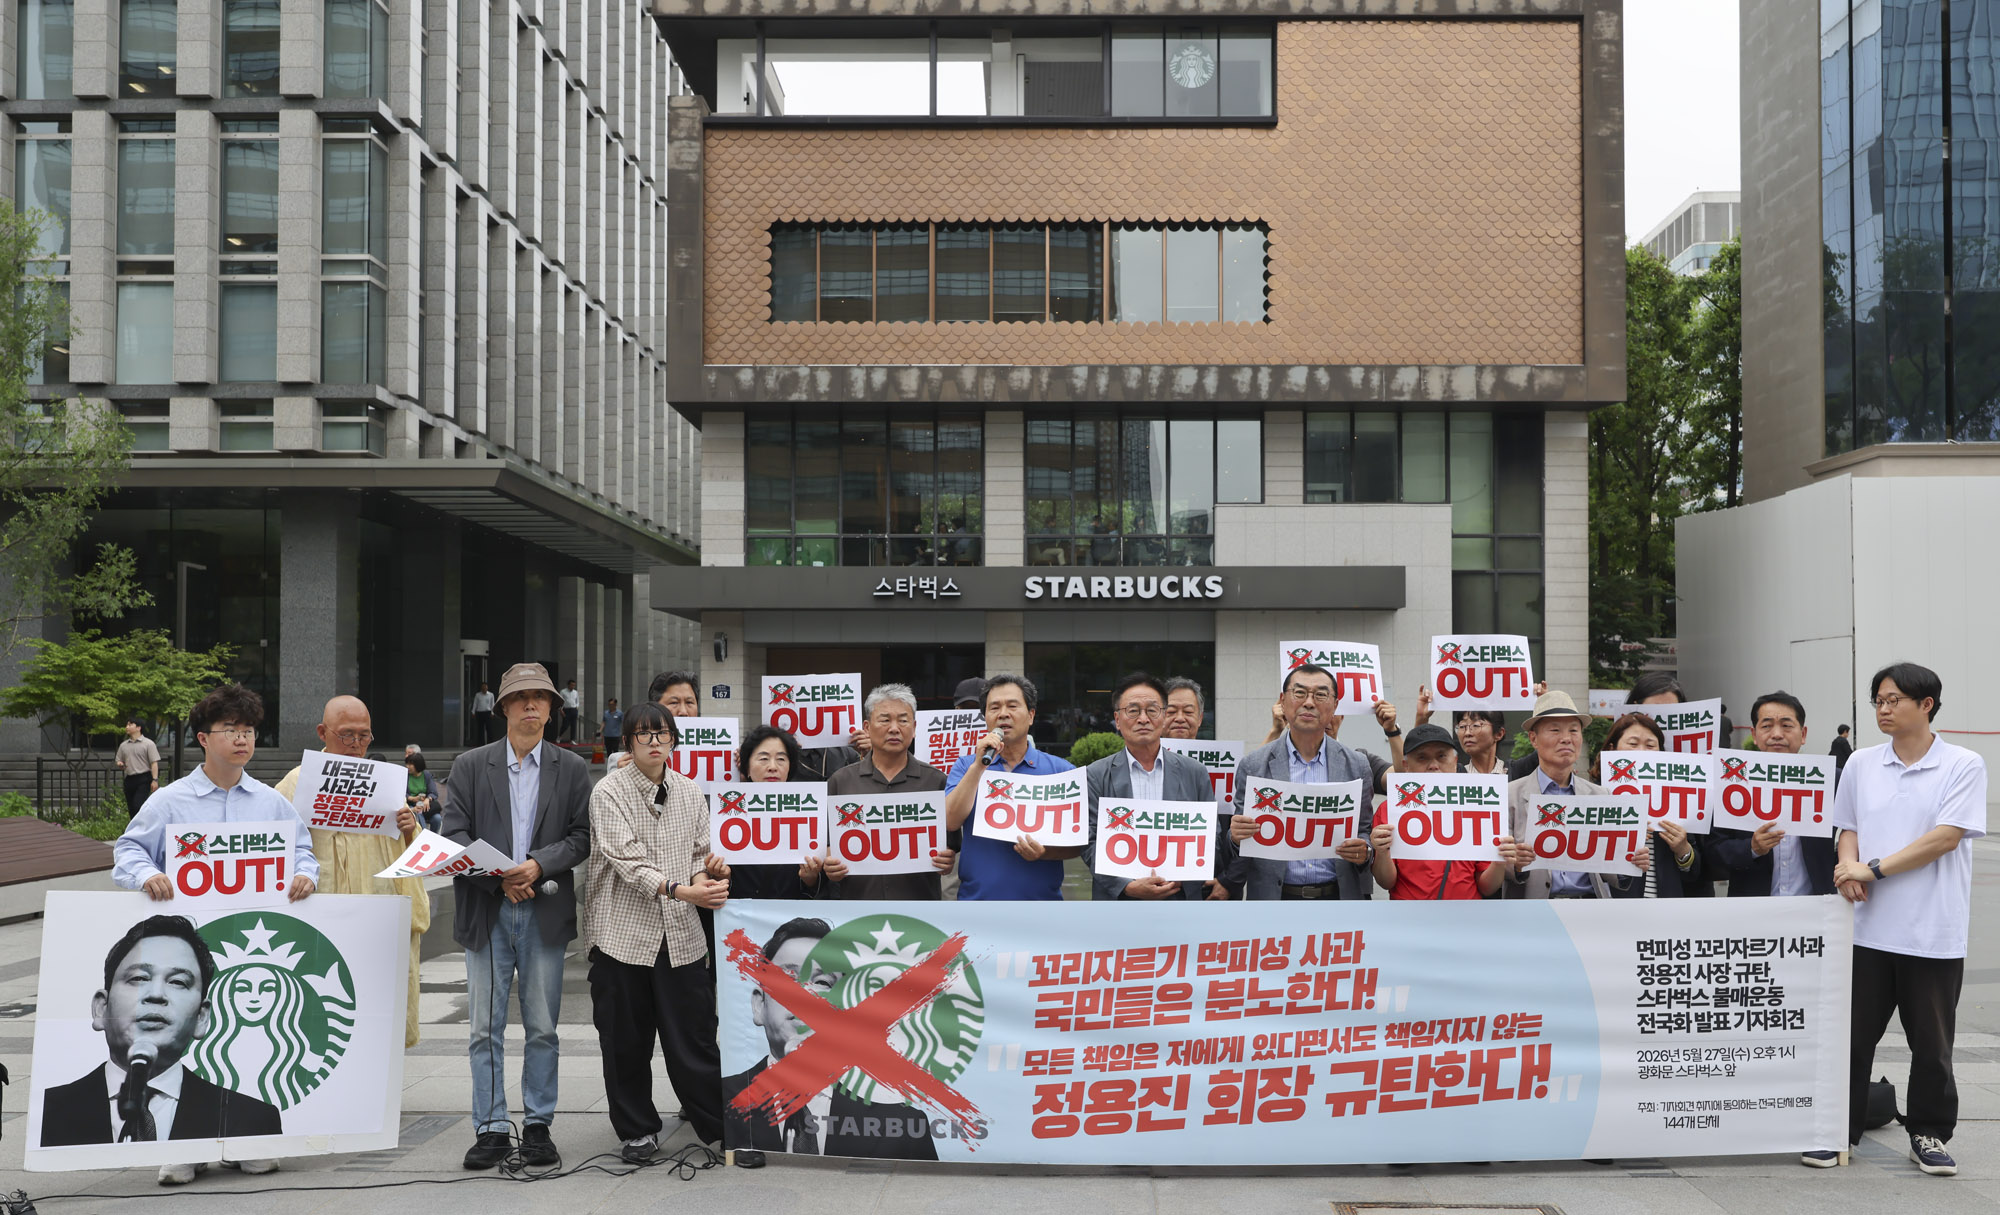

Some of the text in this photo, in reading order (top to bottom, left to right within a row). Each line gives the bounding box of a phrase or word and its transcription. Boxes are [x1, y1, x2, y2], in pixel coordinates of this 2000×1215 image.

[873, 576, 961, 600] 스타벅스
[1025, 575, 1223, 600] STARBUCKS
[1314, 650, 1374, 669] 스타벅스
[1463, 645, 1525, 663] 스타벅스
[795, 683, 854, 702] 스타벅스
[1436, 666, 1529, 698] OUT!
[770, 705, 857, 736] OUT!
[928, 713, 986, 732] 스타벅스
[928, 732, 958, 748] 역사
[322, 760, 375, 780] 대국민
[666, 750, 732, 782] UT!
[1638, 762, 1707, 782] 스타벅스
[1748, 763, 1825, 784] 스타벅스
[319, 777, 377, 797] 사과쇼!
[1014, 780, 1081, 801] 스타벅스
[1427, 785, 1500, 805] 스타벅스
[313, 794, 366, 813] 정용진
[747, 793, 818, 812] 스타벅스
[866, 803, 937, 824] 스타벅스
[1283, 794, 1355, 814] 스타벅스
[1612, 784, 1707, 821] UT!
[1722, 784, 1824, 823] OUT!
[311, 810, 386, 829] 규탄한다!
[984, 802, 1081, 834] OUT!
[1135, 811, 1207, 830] 스타벅스
[1566, 806, 1639, 825] 스타벅스
[719, 817, 818, 851] OUT!
[1252, 814, 1354, 848] OUT!
[1398, 810, 1501, 847] OUT!
[209, 833, 286, 854] 스타벅스
[839, 826, 938, 862] OUT!
[1105, 833, 1207, 868] OUT!
[1533, 829, 1638, 862] OUT!
[176, 857, 286, 897] OUT!
[1197, 936, 1292, 976] 면피성
[1299, 930, 1365, 967] 사과
[1636, 936, 1825, 960] 면피성 꼬리자르기 사과
[1636, 961, 1775, 985] 정용진 사장 규탄,
[1034, 982, 1193, 1032] 국민들은
[1636, 986, 1785, 1009] 스타벅스 불매운동
[1637, 1008, 1805, 1034] 전국화 발표 기자회견
[1083, 1042, 1160, 1072] 책임은
[1166, 1035, 1245, 1066] 저에게
[1251, 1025, 1377, 1062] 있다면서도
[1384, 1016, 1486, 1048] 책임지지
[1491, 1012, 1543, 1041] 않는
[1636, 1045, 1796, 1063] 2026년 5월 27일(수) 오후 1시
[1637, 1063, 1736, 1079] 광화문 스타벅스 앞
[1031, 1074, 1191, 1139] 정용진
[1203, 1064, 1316, 1126] 회장
[1660, 1101, 1695, 1113] 기자회견
[1696, 1100, 1722, 1112] 취지에
[1722, 1099, 1758, 1111] 동의하는
[1758, 1098, 1776, 1110] 전국
[1776, 1098, 1794, 1109] 단체
[1795, 1097, 1813, 1107] 연명
[804, 1114, 989, 1139] STARBUCKS
[1664, 1115, 1720, 1129] 144개 단체
